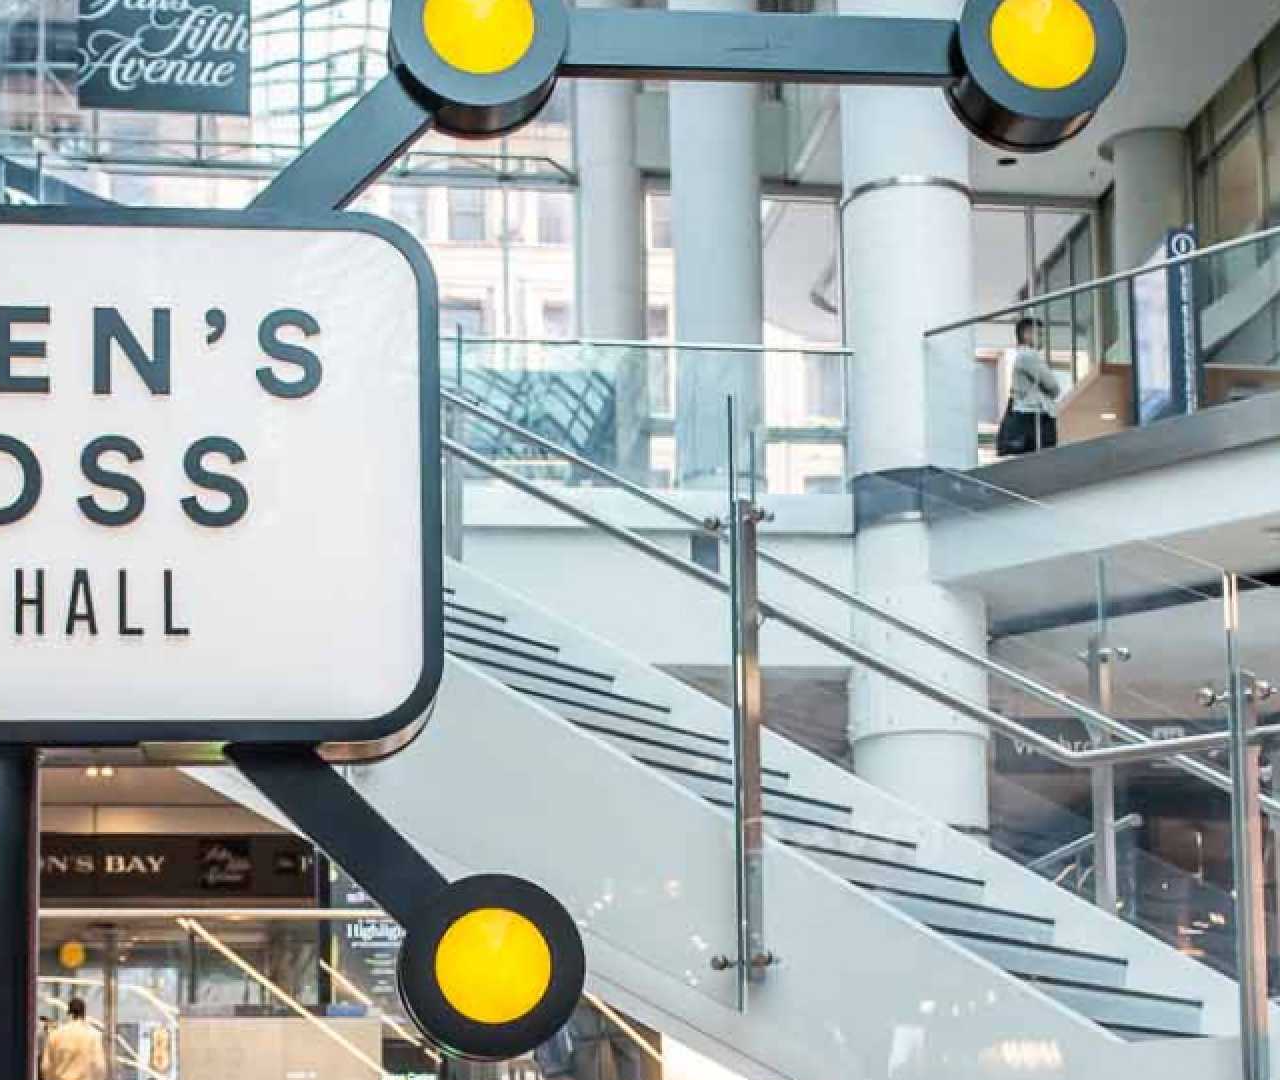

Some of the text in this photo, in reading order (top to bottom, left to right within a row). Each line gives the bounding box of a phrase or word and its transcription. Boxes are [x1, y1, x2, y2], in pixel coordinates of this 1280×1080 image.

[137, 5, 249, 58] Fifth
[76, 30, 237, 91] Avenue
[14, 568, 190, 637] HALL
[104, 854, 166, 874] BAY
